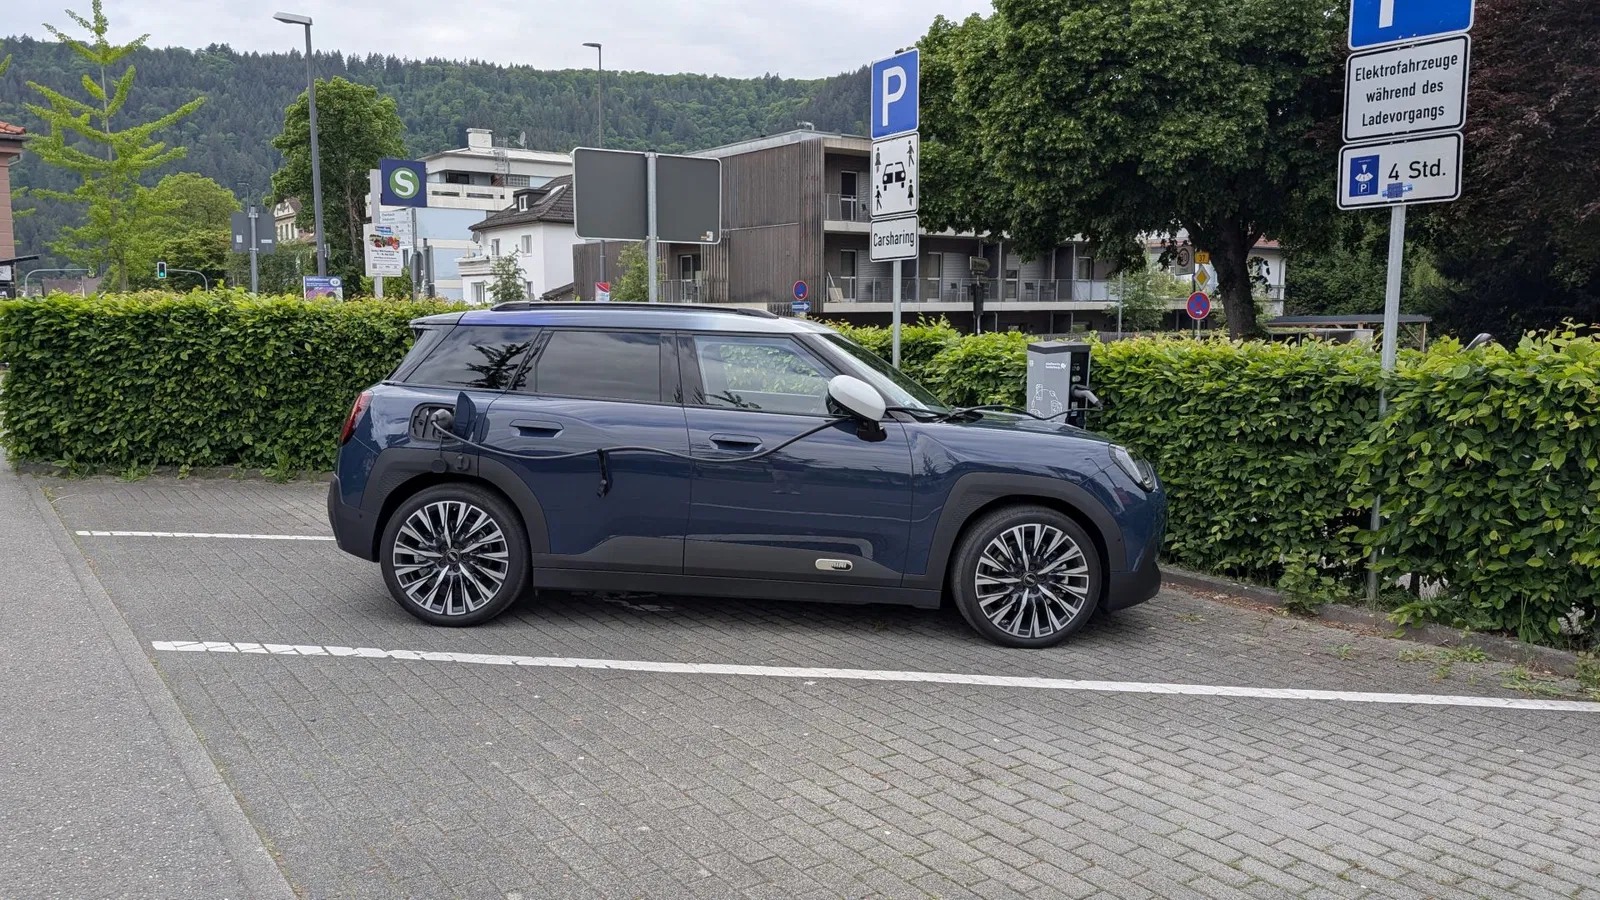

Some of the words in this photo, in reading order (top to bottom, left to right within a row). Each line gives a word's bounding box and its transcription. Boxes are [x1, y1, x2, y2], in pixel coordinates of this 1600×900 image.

[1355, 54, 1458, 82] Elektrofahrzeuge
[882, 65, 907, 127] P
[1366, 82, 1416, 103] während
[1422, 80, 1444, 95] des
[1362, 104, 1445, 127] Ladevorgangs
[1388, 162, 1400, 181] 4
[1408, 158, 1446, 179] Std.
[394, 169, 415, 196] S
[1360, 183, 1367, 193] P
[873, 229, 915, 248] Carsharing
